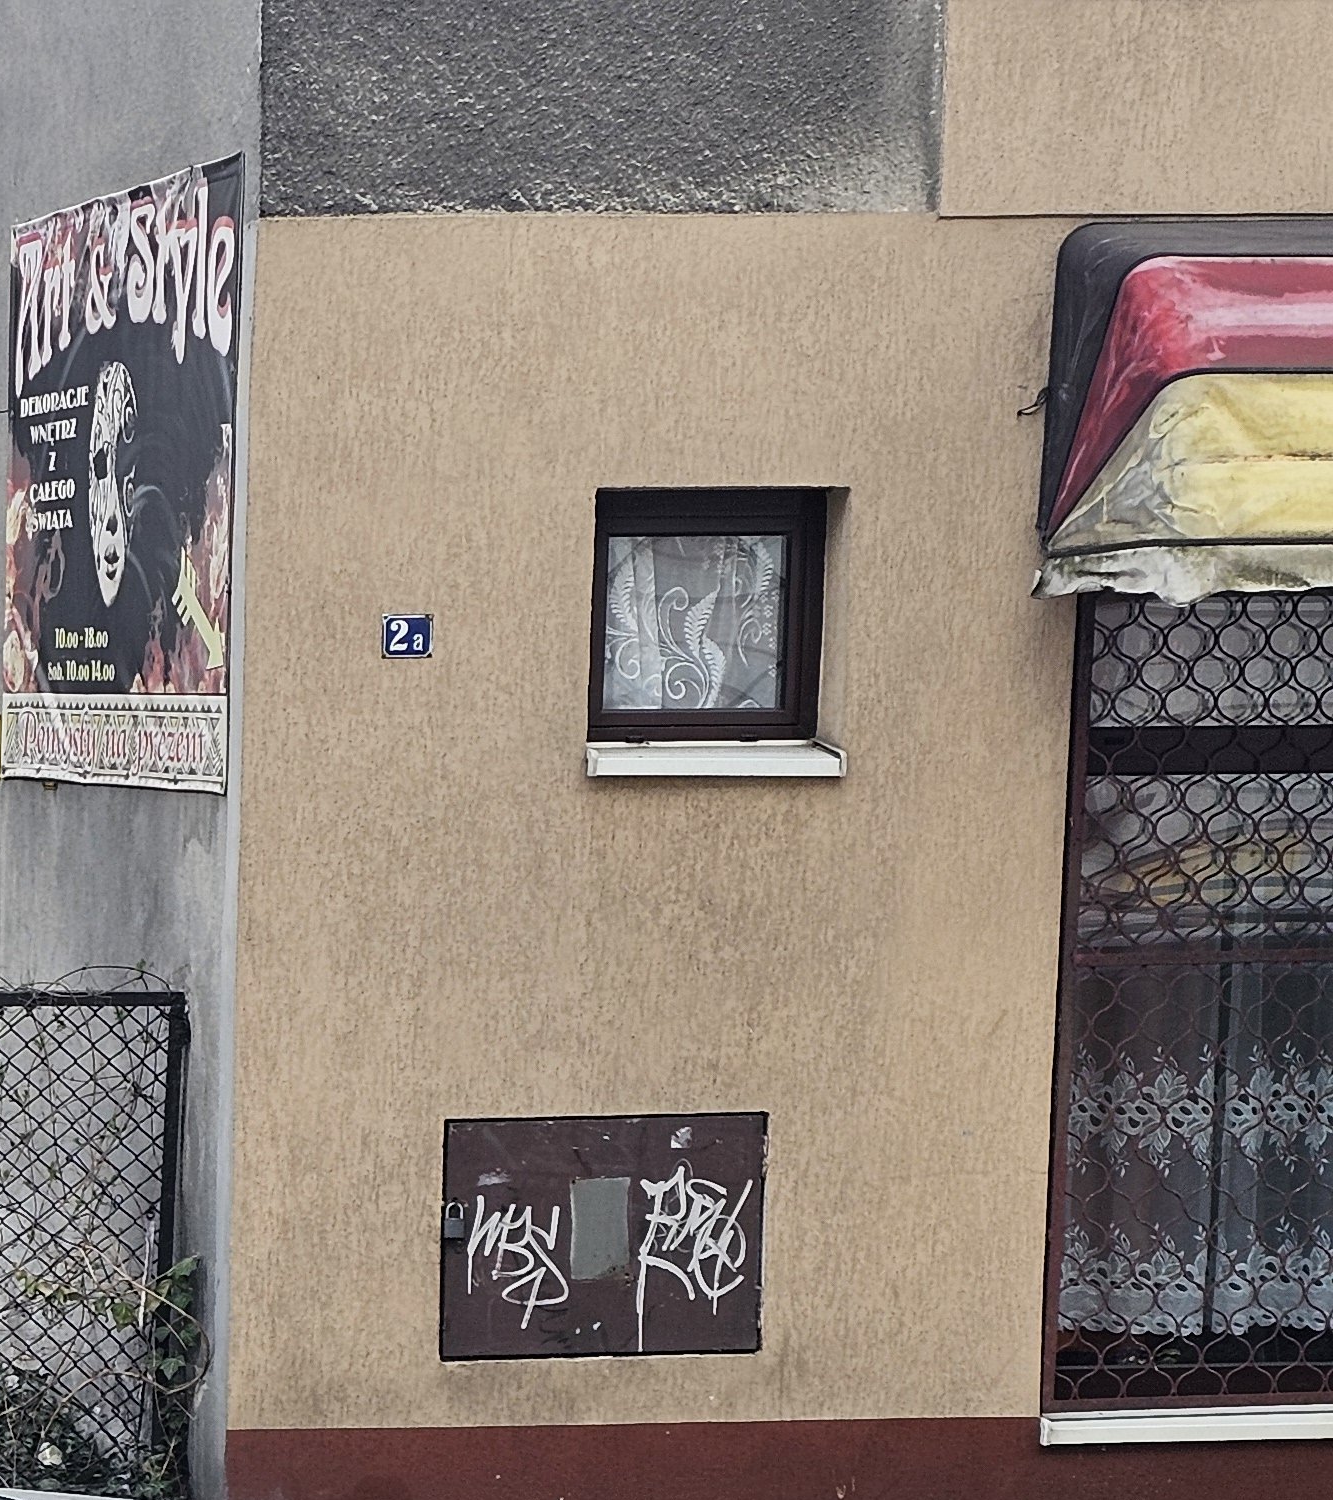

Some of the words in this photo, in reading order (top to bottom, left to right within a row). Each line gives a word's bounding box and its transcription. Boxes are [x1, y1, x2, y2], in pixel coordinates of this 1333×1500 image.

[15, 230, 76, 398] Art
[85, 236, 117, 334] &
[127, 178, 234, 365] Style
[20, 386, 89, 418] DEKORACJE
[30, 418, 77, 446] WNĘTRZ
[30, 479, 75, 503] CAŁEGO
[32, 508, 73, 532] ŚWIATA
[105, 728, 128, 760] na
[132, 727, 207, 775] prezent
